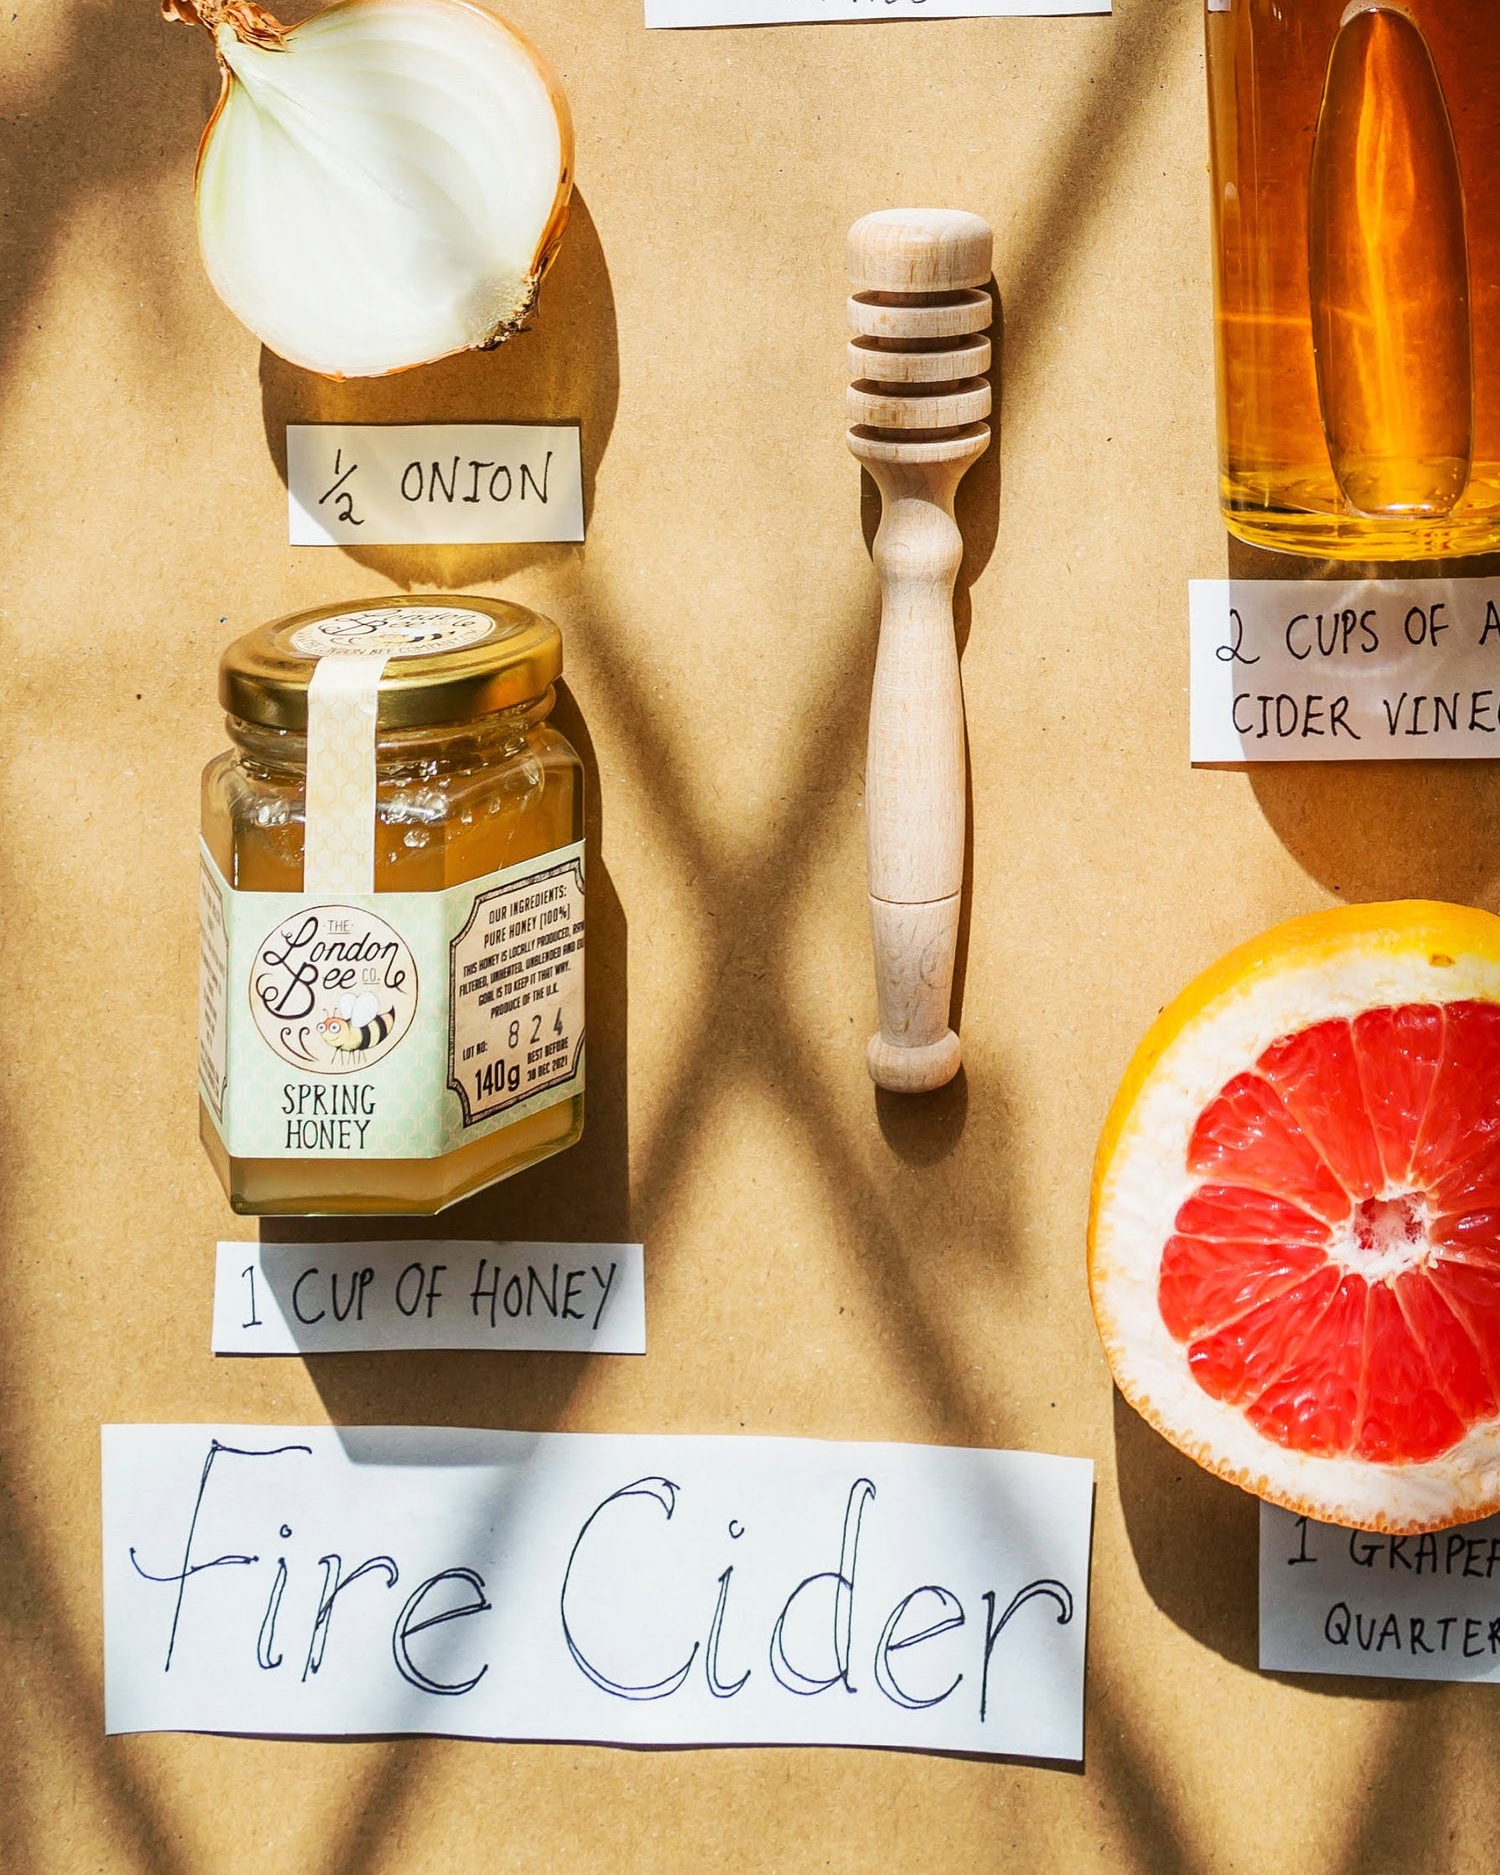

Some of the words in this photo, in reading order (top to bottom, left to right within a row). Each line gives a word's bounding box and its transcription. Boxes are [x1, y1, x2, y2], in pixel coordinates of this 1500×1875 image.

[400, 450, 553, 504] ONION
[1215, 608, 1261, 665] 2
[1285, 608, 1380, 661] CUPS
[1403, 602, 1450, 647] OF
[1231, 692, 1362, 741] CIDER
[489, 907, 507, 923] OUR
[510, 886, 567, 916] INGREDIENTS:
[327, 919, 351, 932] THE
[484, 929, 506, 947] PURE
[509, 917, 537, 938] HONEY
[263, 916, 407, 994] London
[463, 959, 477, 976] THIS
[479, 955, 500, 970] HONEY
[501, 949, 507, 961] IS
[509, 940, 535, 958] LOCALLY
[526, 948, 561, 968] UNBLENDED
[563, 941, 575, 954] AND
[256, 961, 357, 1020] Bee
[478, 989, 494, 1005] GOAL
[496, 985, 503, 997] IS
[504, 982, 512, 993] TO
[514, 977, 529, 990] KEEP
[530, 974, 536, 984] IT
[538, 968, 553, 981] THAT
[491, 1001, 520, 1018] PRODUCE
[522, 995, 531, 1005] OF
[533, 989, 544, 1001] THE
[462, 1047, 474, 1060] LOT
[477, 1041, 488, 1054] NO:
[527, 1048, 543, 1063] BEST
[544, 1037, 569, 1056] BEFORE
[538, 1063, 550, 1076] DEC
[552, 1056, 568, 1070] 2021
[475, 1060, 520, 1100] 140g
[281, 1083, 376, 1116] SPRING
[284, 1119, 370, 1149] HONEY
[241, 1264, 263, 1329] 1
[292, 1267, 375, 1325] CUP
[395, 1261, 448, 1319] OF
[469, 1258, 618, 1331] HONEY
[1287, 1517, 1318, 1566] 1
[129, 1438, 493, 1697] Fire
[560, 1476, 1074, 1724] Cider
